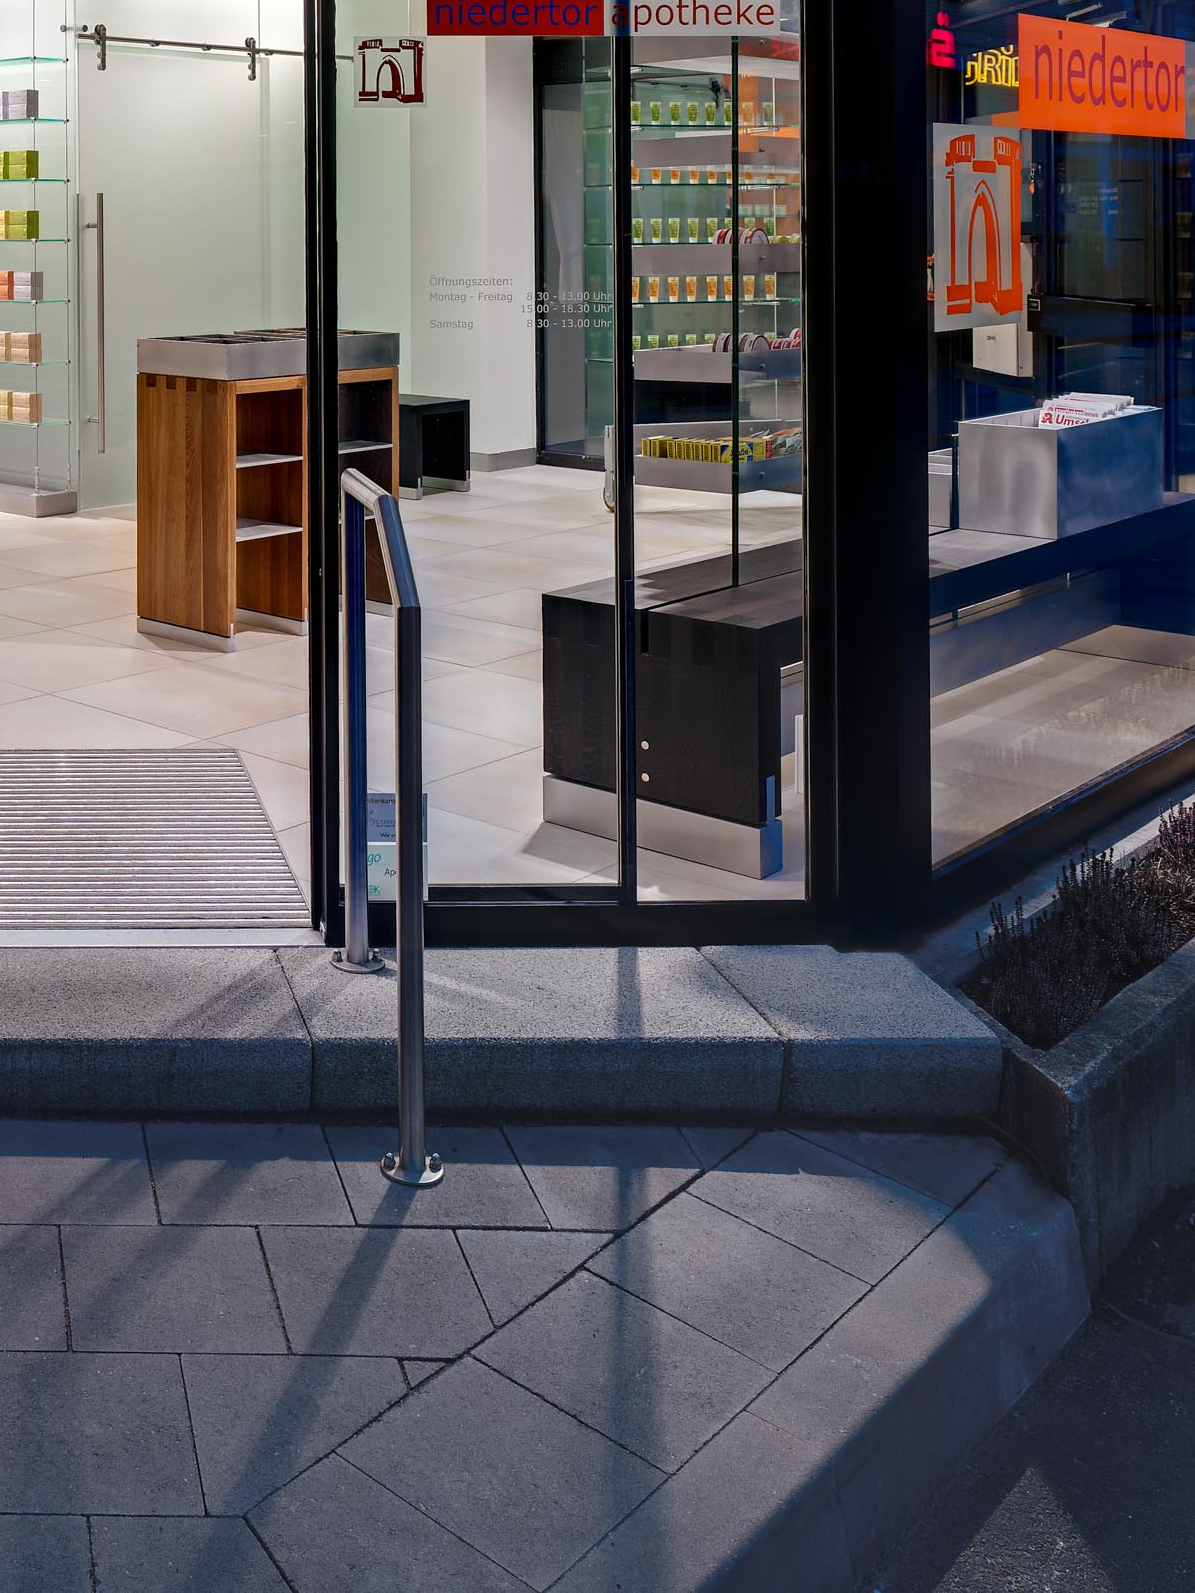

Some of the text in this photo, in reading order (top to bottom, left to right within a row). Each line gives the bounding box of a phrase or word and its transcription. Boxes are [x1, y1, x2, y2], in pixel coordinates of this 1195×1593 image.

[1033, 29, 1185, 113] niedertor
[429, 276, 513, 288] Öffnungszeiten:
[429, 292, 467, 302] Montag
[478, 292, 513, 302] Freitag
[562, 292, 590, 301] 13.00
[593, 292, 612, 301] Uhr
[562, 304, 590, 313] 18.30
[593, 304, 612, 313] Uhr
[429, 319, 474, 329] Samstag
[562, 319, 590, 328] 13.00
[593, 319, 612, 328] Uhr
